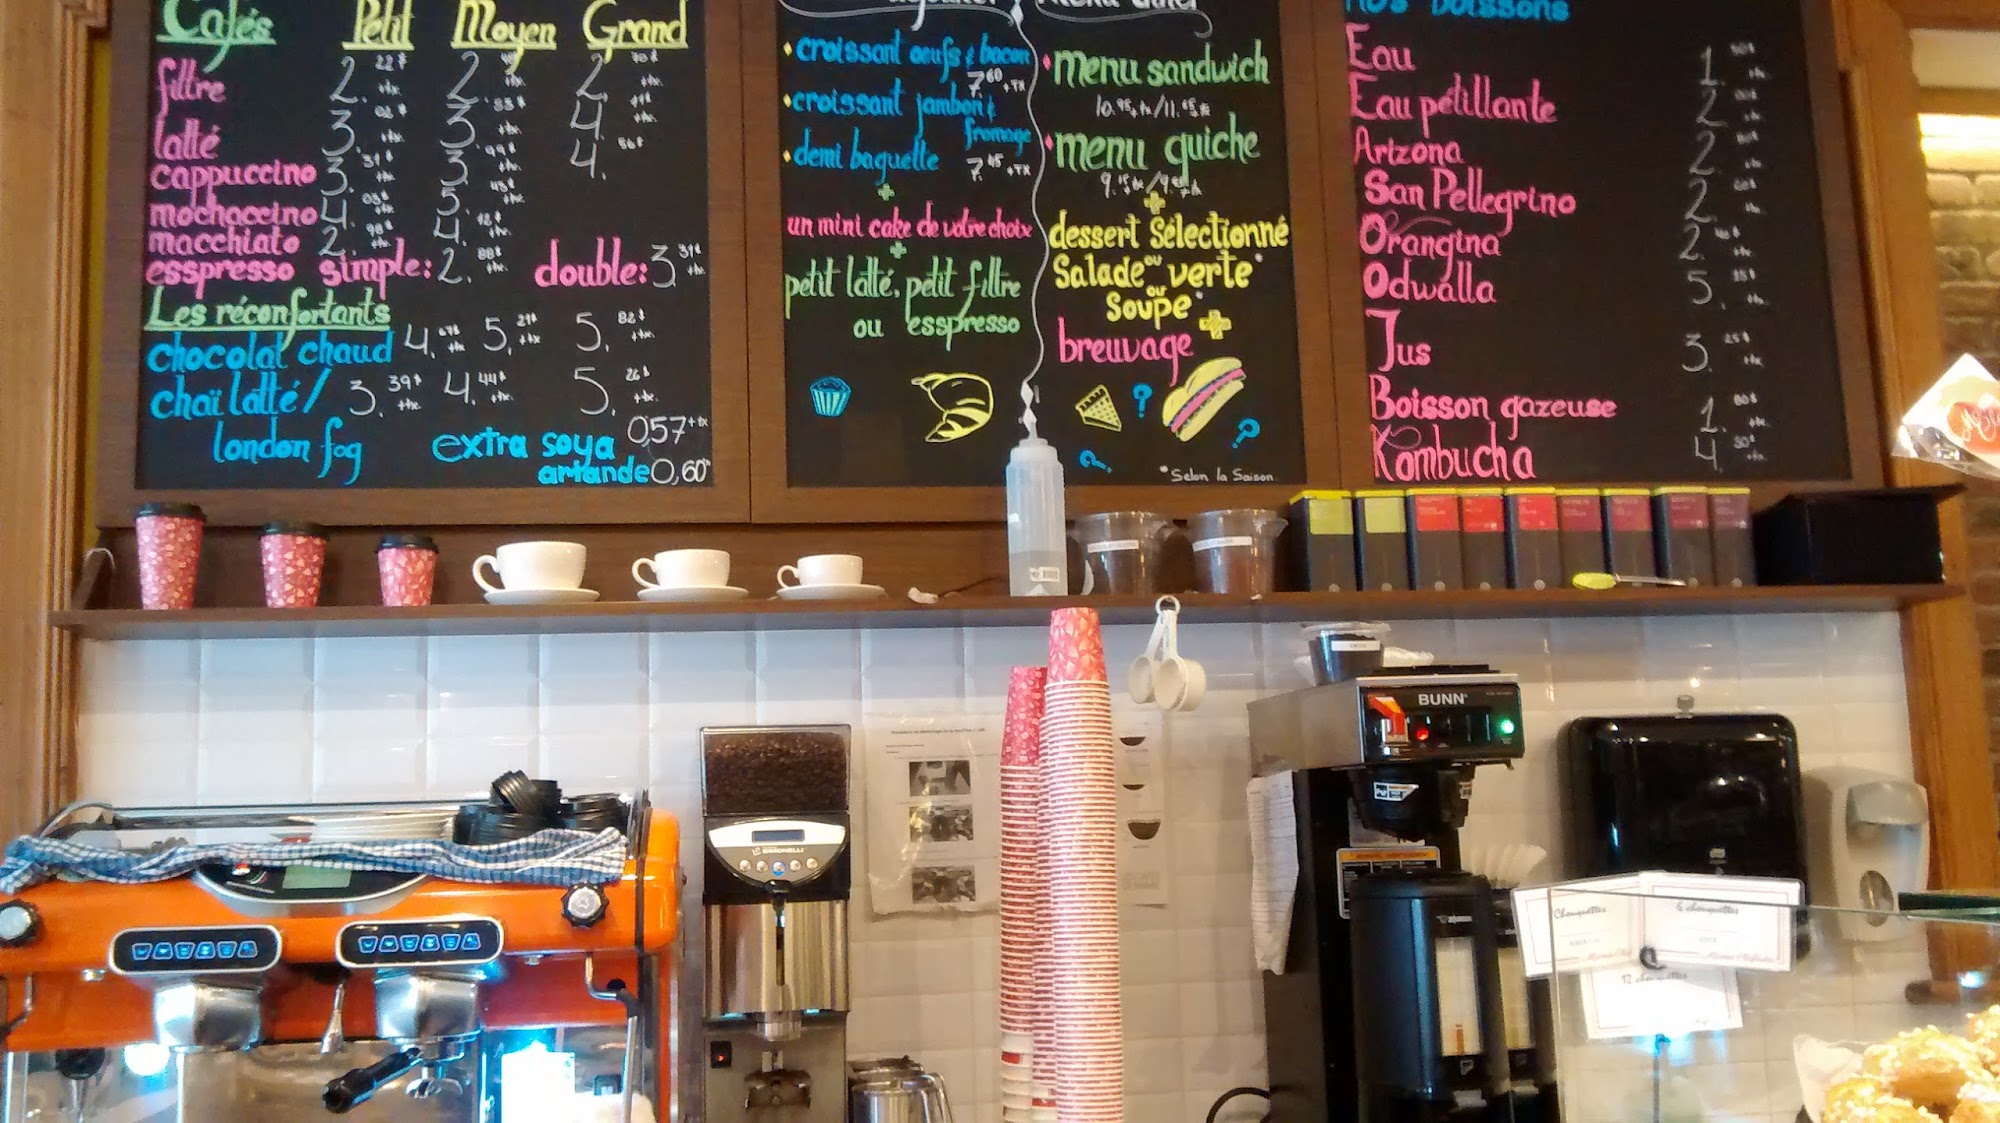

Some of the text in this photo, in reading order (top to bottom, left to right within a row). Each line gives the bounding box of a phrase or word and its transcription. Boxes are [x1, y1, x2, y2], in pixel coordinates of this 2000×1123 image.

[450, 0, 557, 74] Moyen
[582, 0, 688, 64] Grand
[796, 28, 902, 65] croissant
[979, 32, 1031, 65] bacon
[1346, 22, 1416, 71] Eau
[157, 57, 226, 108] filtre
[1147, 38, 1270, 88] sandwich
[793, 77, 902, 116] croissant
[915, 82, 984, 137] jambon
[1349, 72, 1413, 120] Eau
[154, 118, 221, 160] latté
[793, 127, 940, 186] demi baguette
[964, 117, 1032, 157] fromage
[1055, 111, 1260, 185] menu quiche
[1354, 125, 1464, 166] Arizona
[150, 159, 318, 207] cappuccino
[1364, 168, 1425, 211] San
[1433, 166, 1577, 236] Pellegrino
[150, 201, 318, 228] mochaccino
[786, 201, 1033, 239] un mini cake de votre choix
[1050, 209, 1140, 250] dessert
[150, 224, 301, 255] macchiato
[1359, 210, 1501, 282] Orangina
[146, 257, 295, 300] esspresso
[318, 237, 432, 300] simple:
[534, 236, 648, 287] double:
[785, 257, 841, 320] petit
[905, 255, 958, 323] petit
[962, 255, 1021, 317] filtre
[1053, 253, 1145, 289] Salade
[1363, 259, 1496, 304] Odwalla
[147, 285, 392, 350] Les réconfortants
[853, 315, 1021, 351] ou esspresso
[1106, 292, 1192, 330] Soupe
[147, 330, 288, 372] chocolat
[298, 330, 394, 364] chaud
[1057, 316, 1194, 386] breuvage
[1365, 308, 1431, 372] Jus
[1369, 373, 1489, 421] Boisson
[1501, 394, 1617, 441] gazeuse
[212, 416, 362, 485] london fog
[432, 426, 528, 462] extra
[542, 431, 615, 468] soya
[1370, 420, 1537, 482] Kombucha
[1171, 467, 1274, 482] Selon la Saison
[1418, 692, 1465, 706] BUNN
